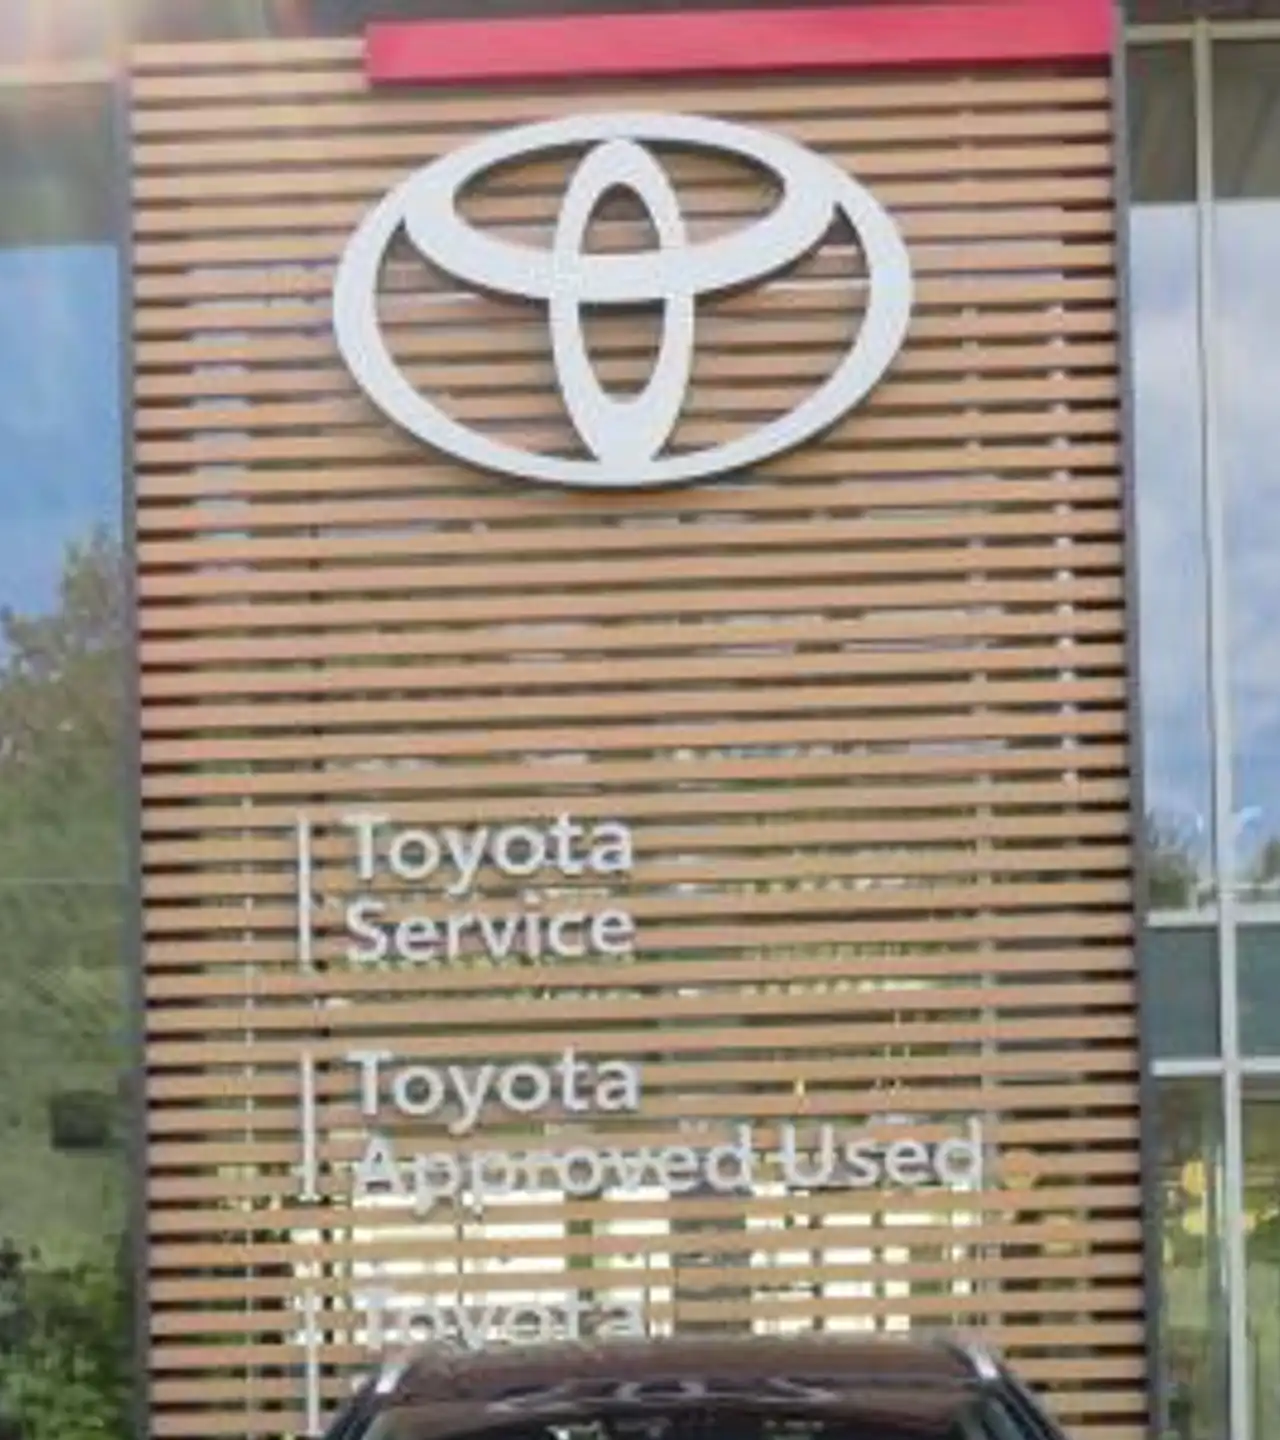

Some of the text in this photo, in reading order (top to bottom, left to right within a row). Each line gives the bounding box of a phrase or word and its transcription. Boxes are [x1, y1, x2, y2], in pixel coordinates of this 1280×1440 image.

[343, 811, 637, 894] Toyota
[345, 889, 638, 964] Service
[346, 1045, 642, 1134] Toyota
[354, 1116, 985, 1216] Approved Used
[354, 1288, 646, 1350] Toyota
